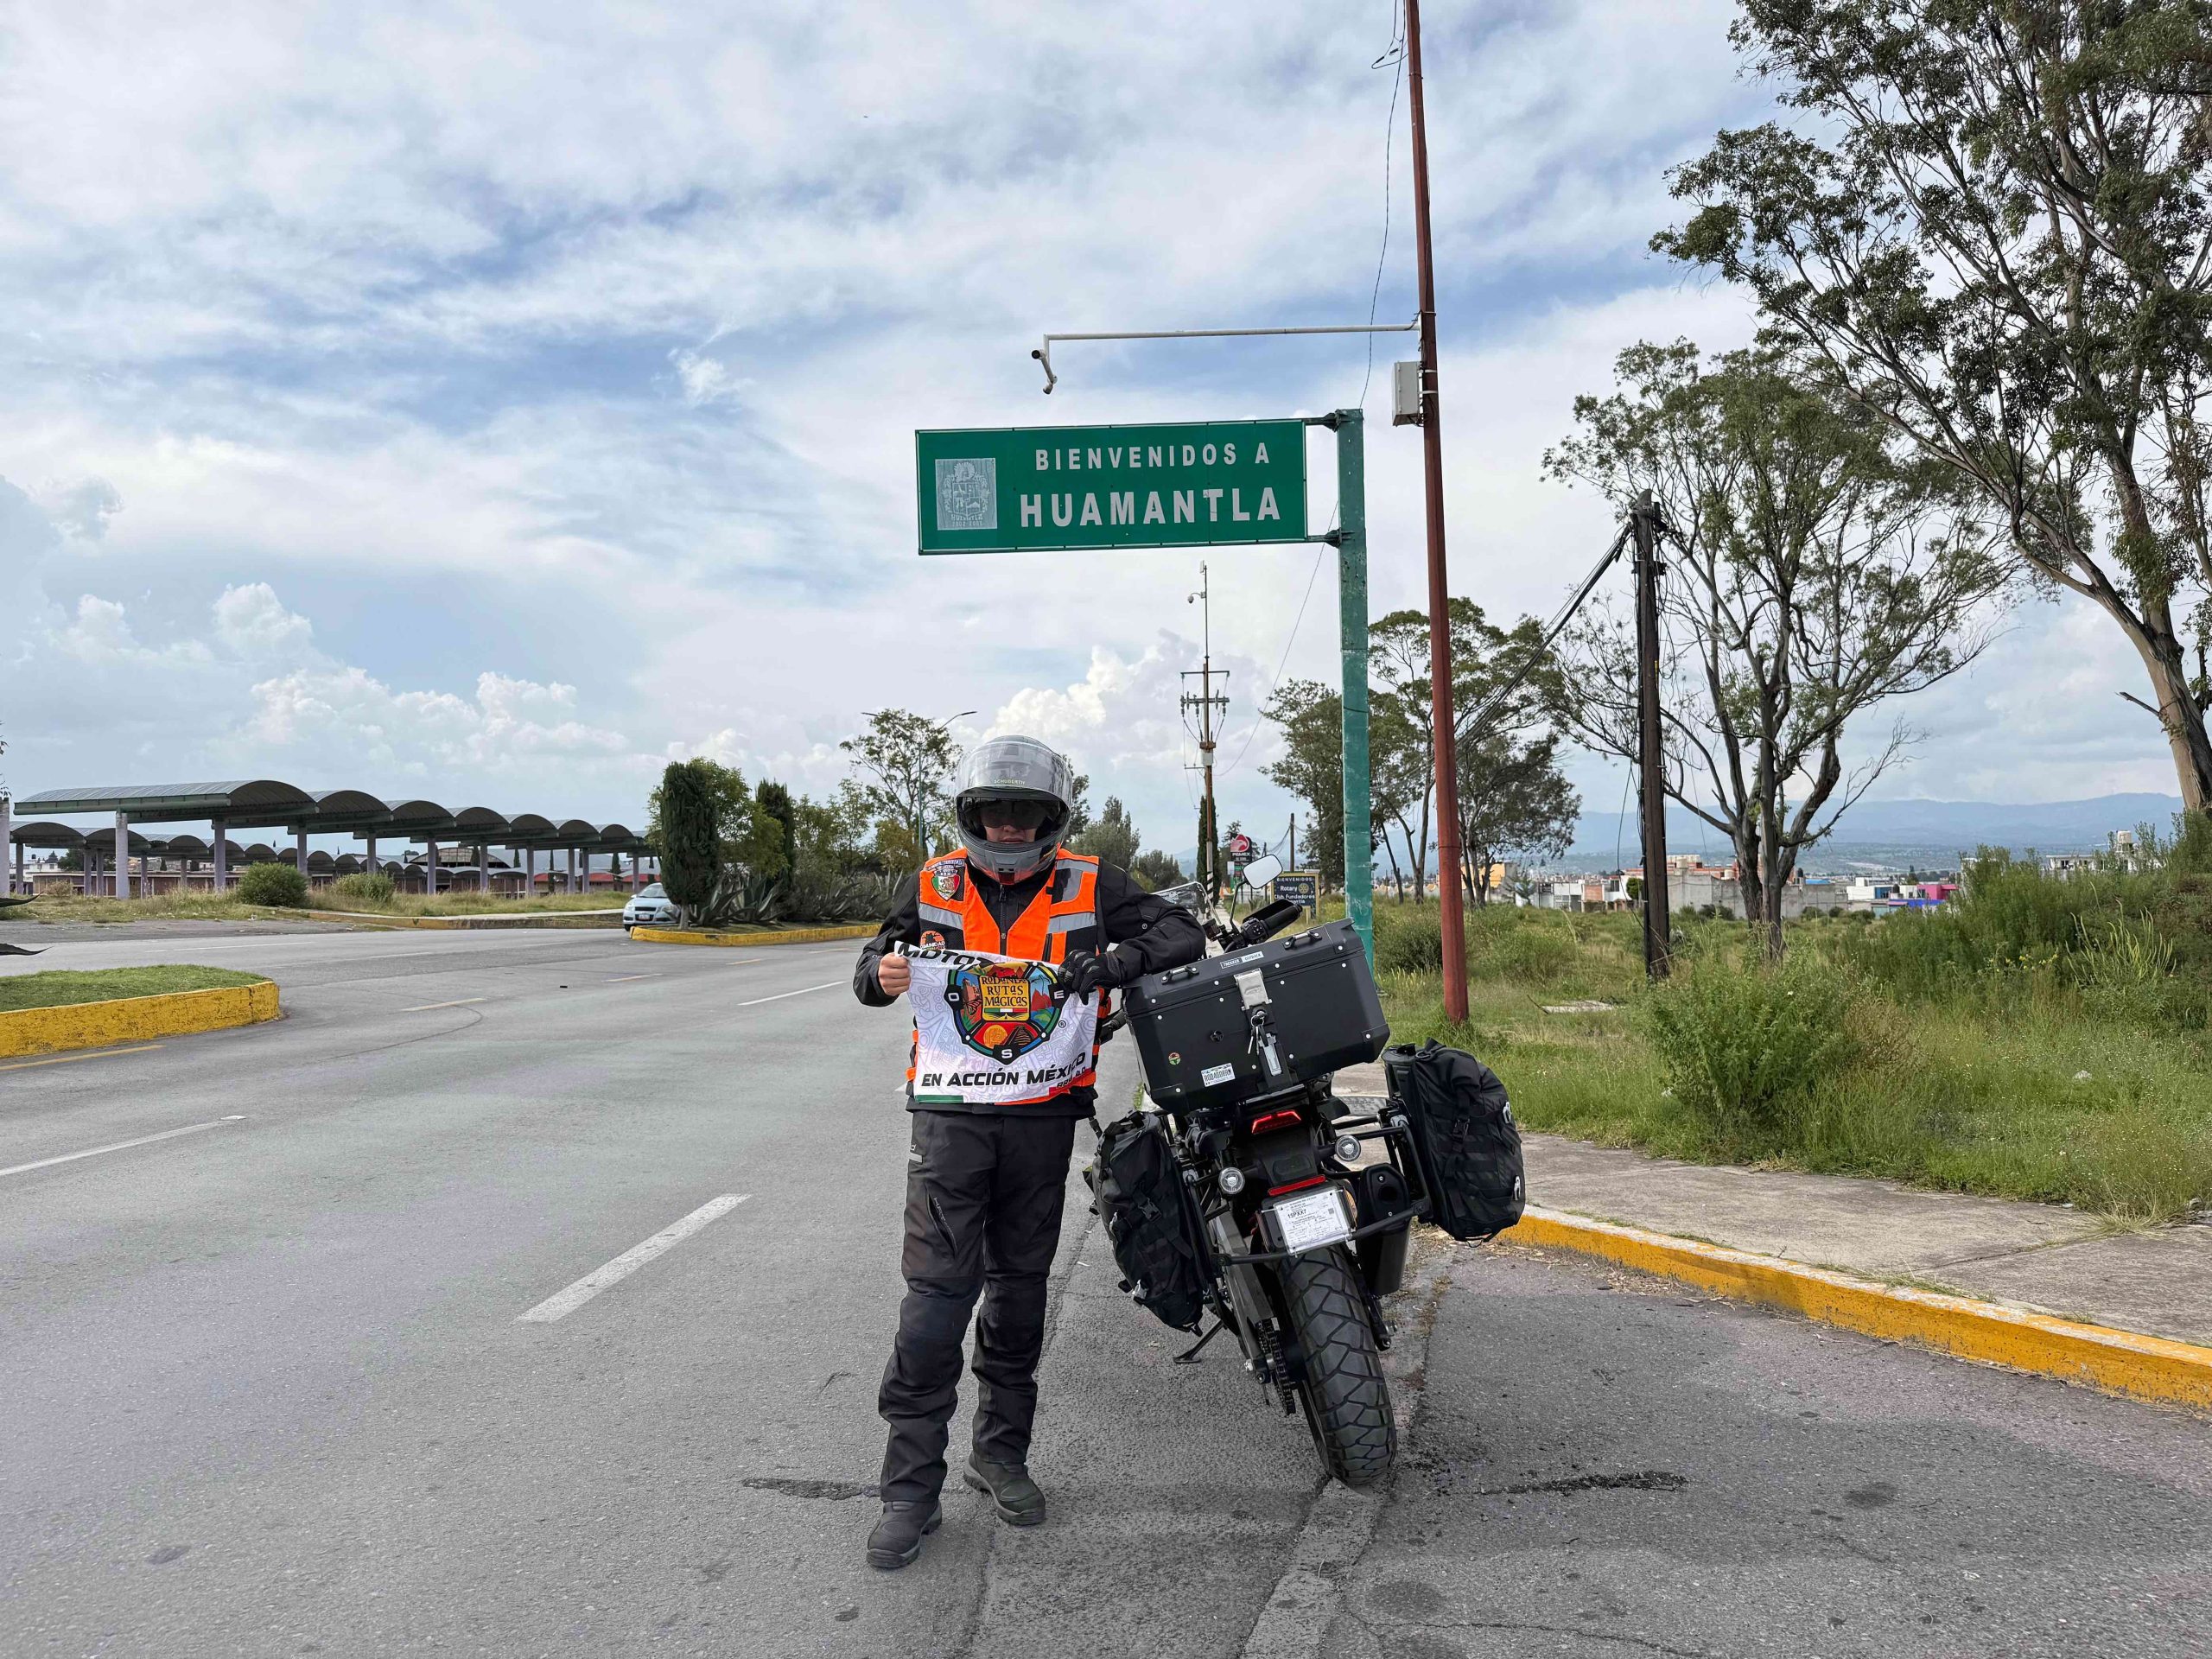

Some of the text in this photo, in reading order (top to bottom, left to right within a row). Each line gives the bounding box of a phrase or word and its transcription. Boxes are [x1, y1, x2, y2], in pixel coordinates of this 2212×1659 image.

[1035, 442, 1269, 471] BIENVENIDOS A
[1020, 486, 1281, 528] HUAMANTLA
[1053, 990, 1065, 999] E
[1001, 1048, 1014, 1058] S
[921, 1073, 943, 1087] EN
[947, 1067, 1020, 1087] ACCIÓN
[1026, 1052, 1086, 1085] MÉXICO
